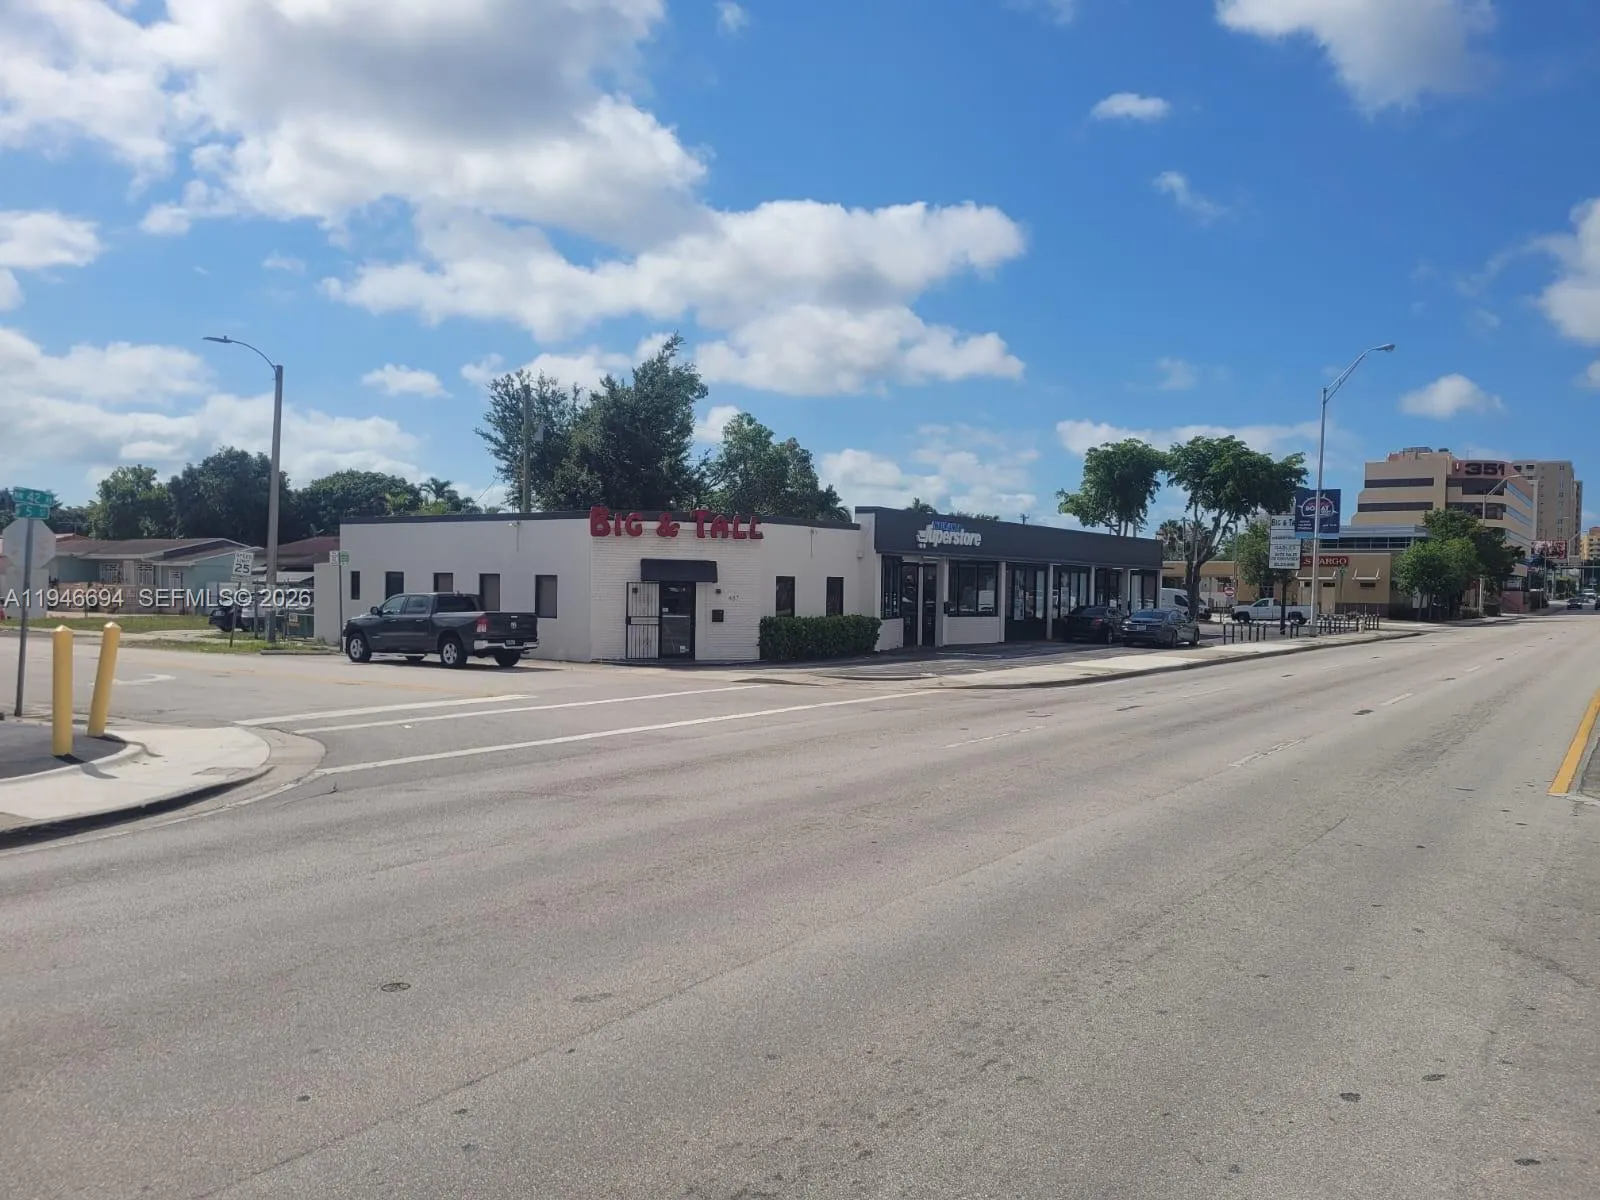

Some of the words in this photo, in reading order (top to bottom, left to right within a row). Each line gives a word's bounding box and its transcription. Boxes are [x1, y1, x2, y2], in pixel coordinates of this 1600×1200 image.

[1464, 463, 1505, 476] 351
[656, 513, 680, 538] &
[1318, 557, 1348, 565] ARGO
[234, 563, 250, 573] 25
